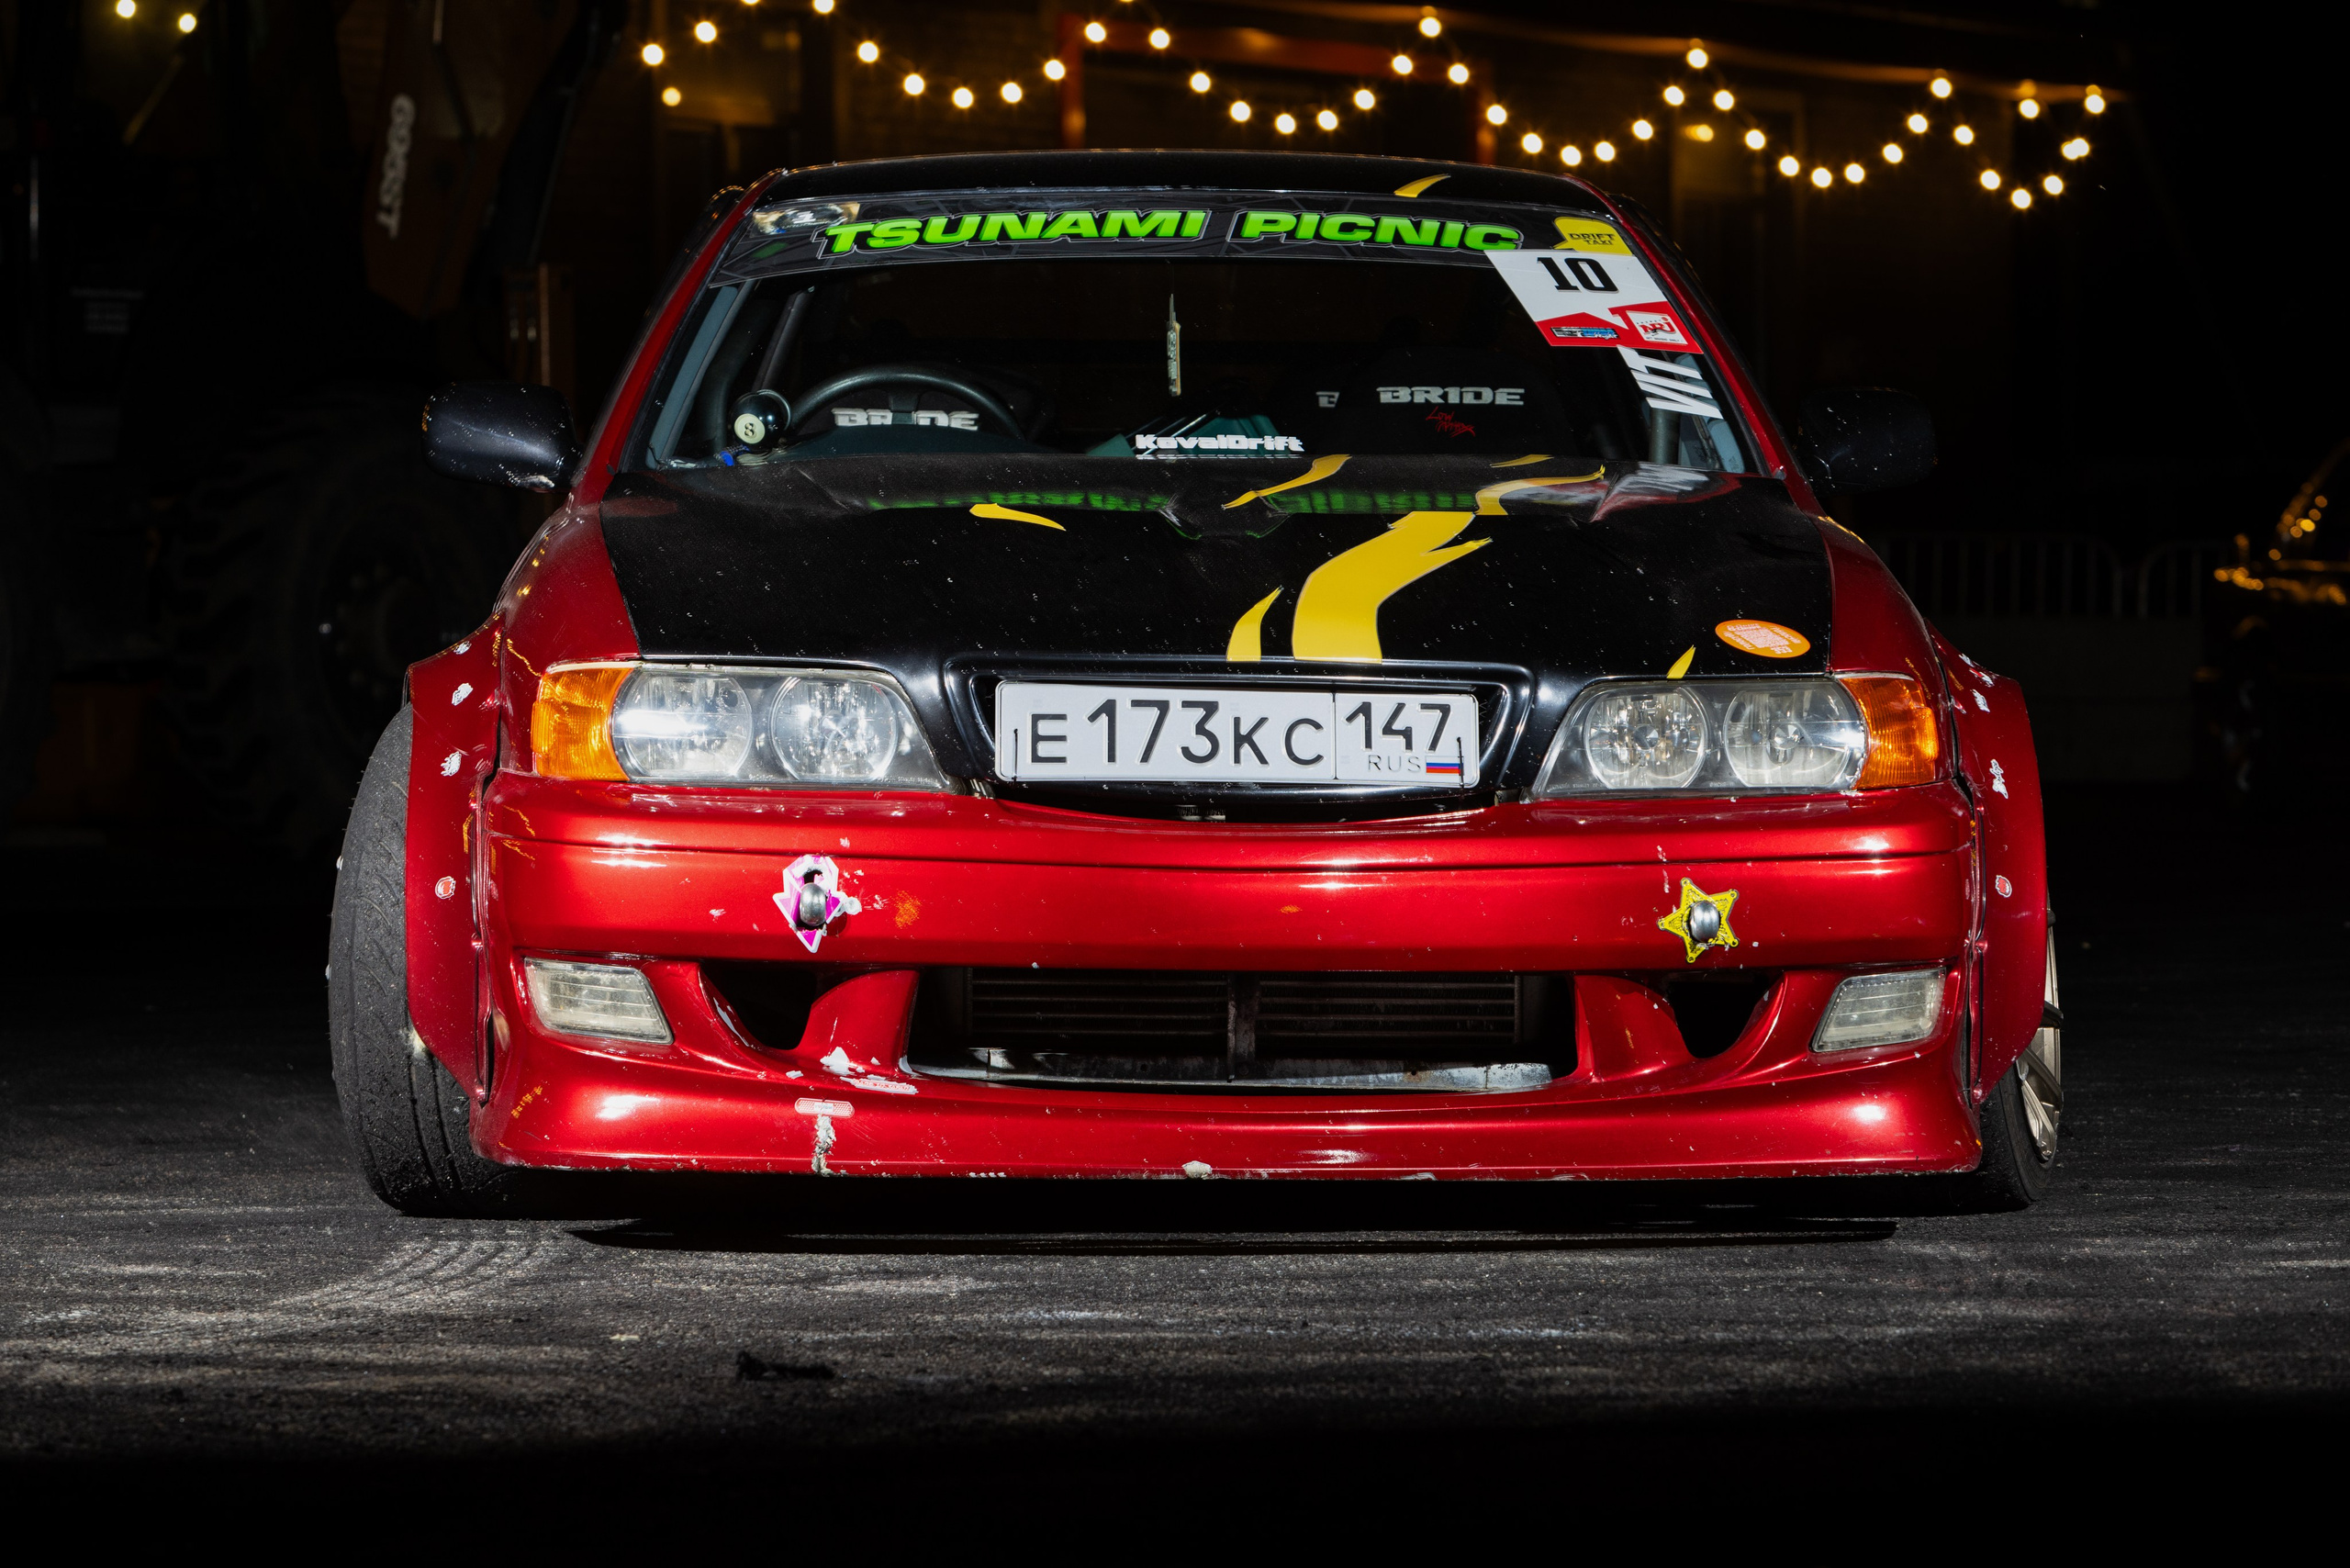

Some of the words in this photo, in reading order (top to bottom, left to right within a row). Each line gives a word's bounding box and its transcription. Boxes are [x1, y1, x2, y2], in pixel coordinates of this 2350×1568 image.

[825, 210, 1206, 253] TSUNAMI
[1239, 210, 1521, 251] PICNIC
[1568, 233, 1616, 241] DRIFT
[1537, 257, 1619, 292] 10
[1376, 386, 1526, 406] BRIDE
[744, 421, 755, 437] 8
[1344, 701, 1452, 752] 147
[1368, 755, 1422, 773] RUS
